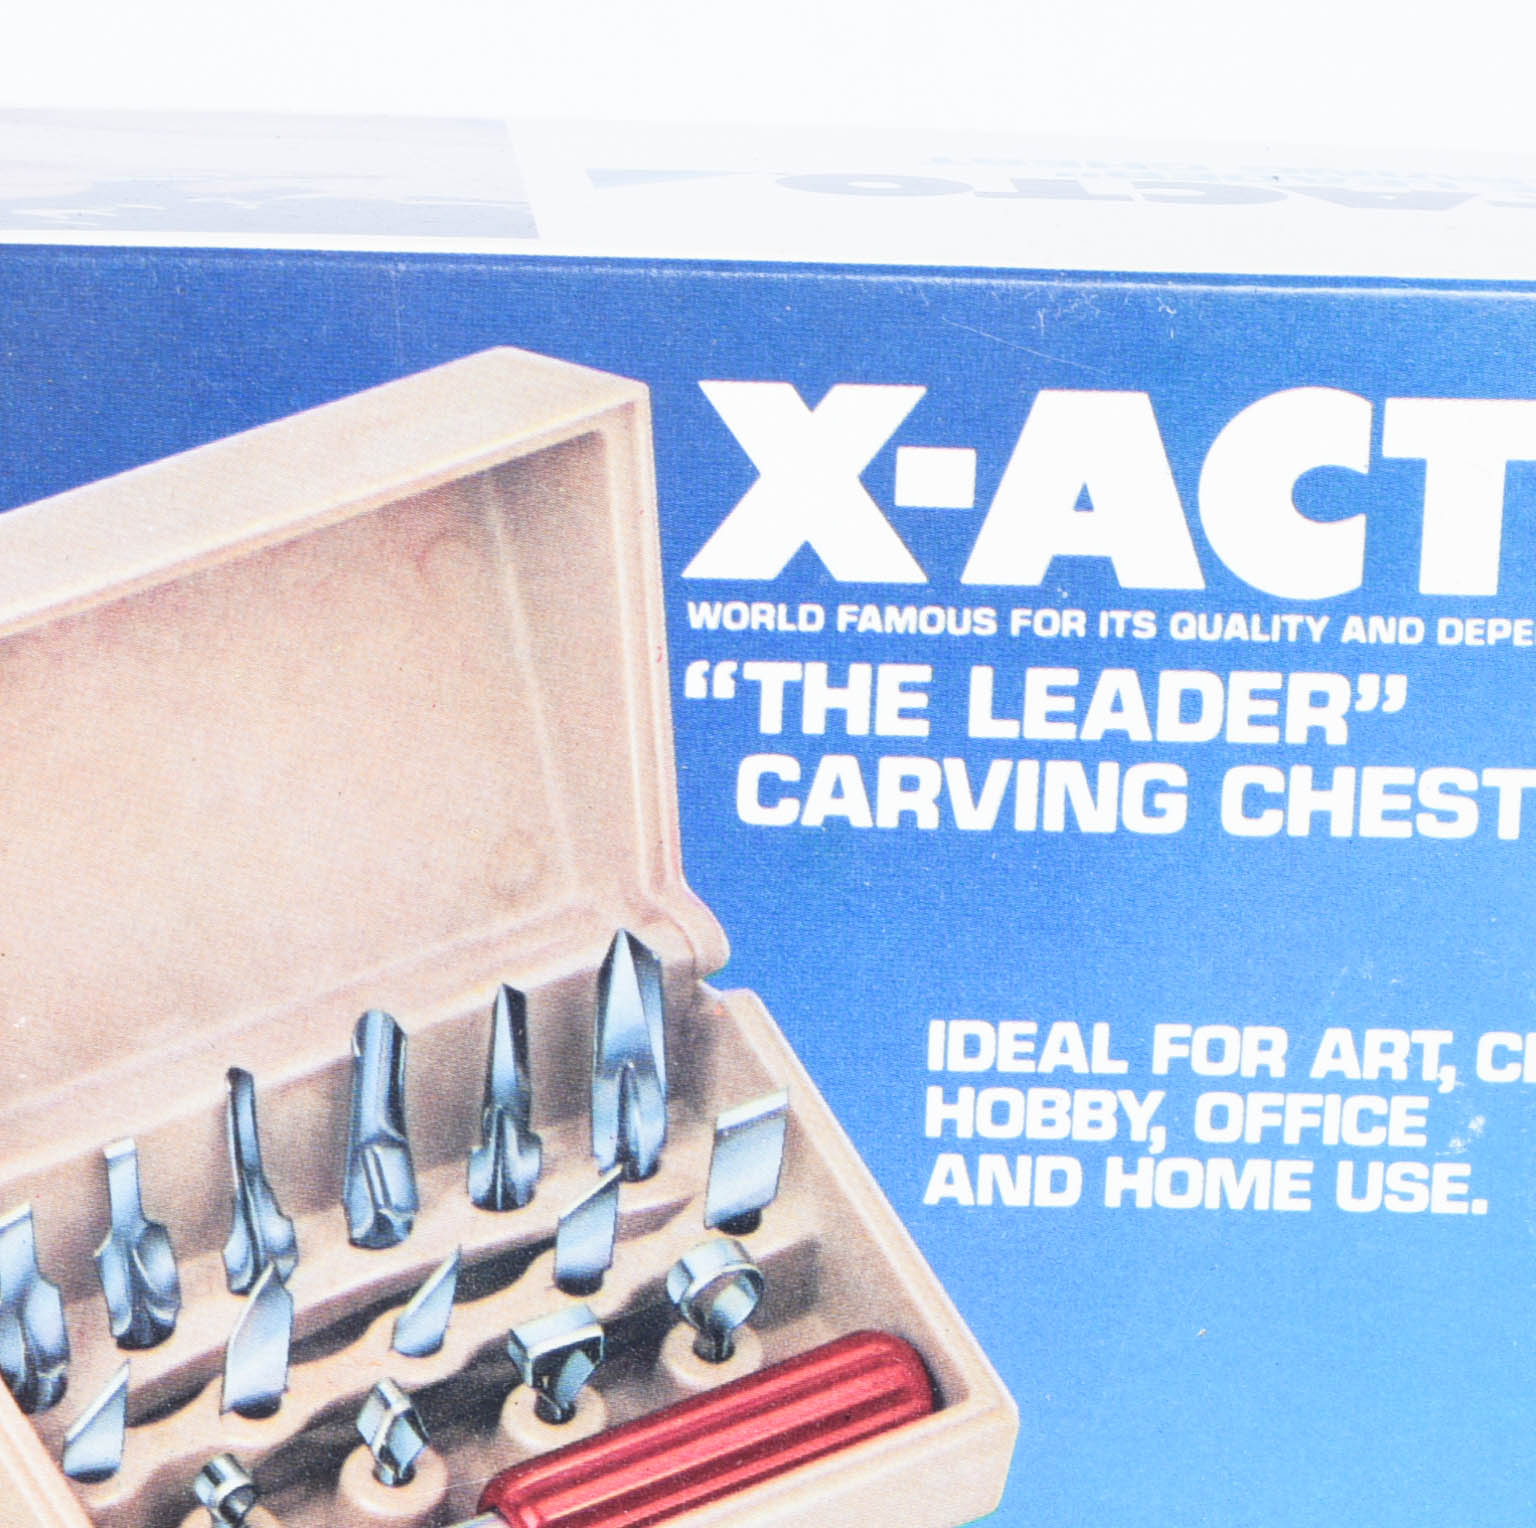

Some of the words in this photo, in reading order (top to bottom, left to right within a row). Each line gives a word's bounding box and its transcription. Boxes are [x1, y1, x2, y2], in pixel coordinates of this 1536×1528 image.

[688, 601, 825, 632] WORLD
[837, 604, 997, 636] FAMOUS
[1011, 608, 1086, 637] FOR
[1099, 610, 1156, 639] ITS
[1170, 611, 1330, 642] QUALITY
[1341, 616, 1425, 644] AND
[685, 660, 932, 737] “THE
[968, 665, 1408, 745] LEADER”
[736, 753, 1188, 834] CARVING
[928, 1020, 1128, 1074] IDEAL
[1152, 1024, 1288, 1077] FOR
[1311, 1027, 1456, 1091] ART,
[925, 1086, 1166, 1158] HOBBY,
[1195, 1091, 1430, 1147] OFFICE
[923, 1153, 1083, 1207] AND
[1104, 1156, 1314, 1211] HOME
[1336, 1160, 1488, 1214] USE.
